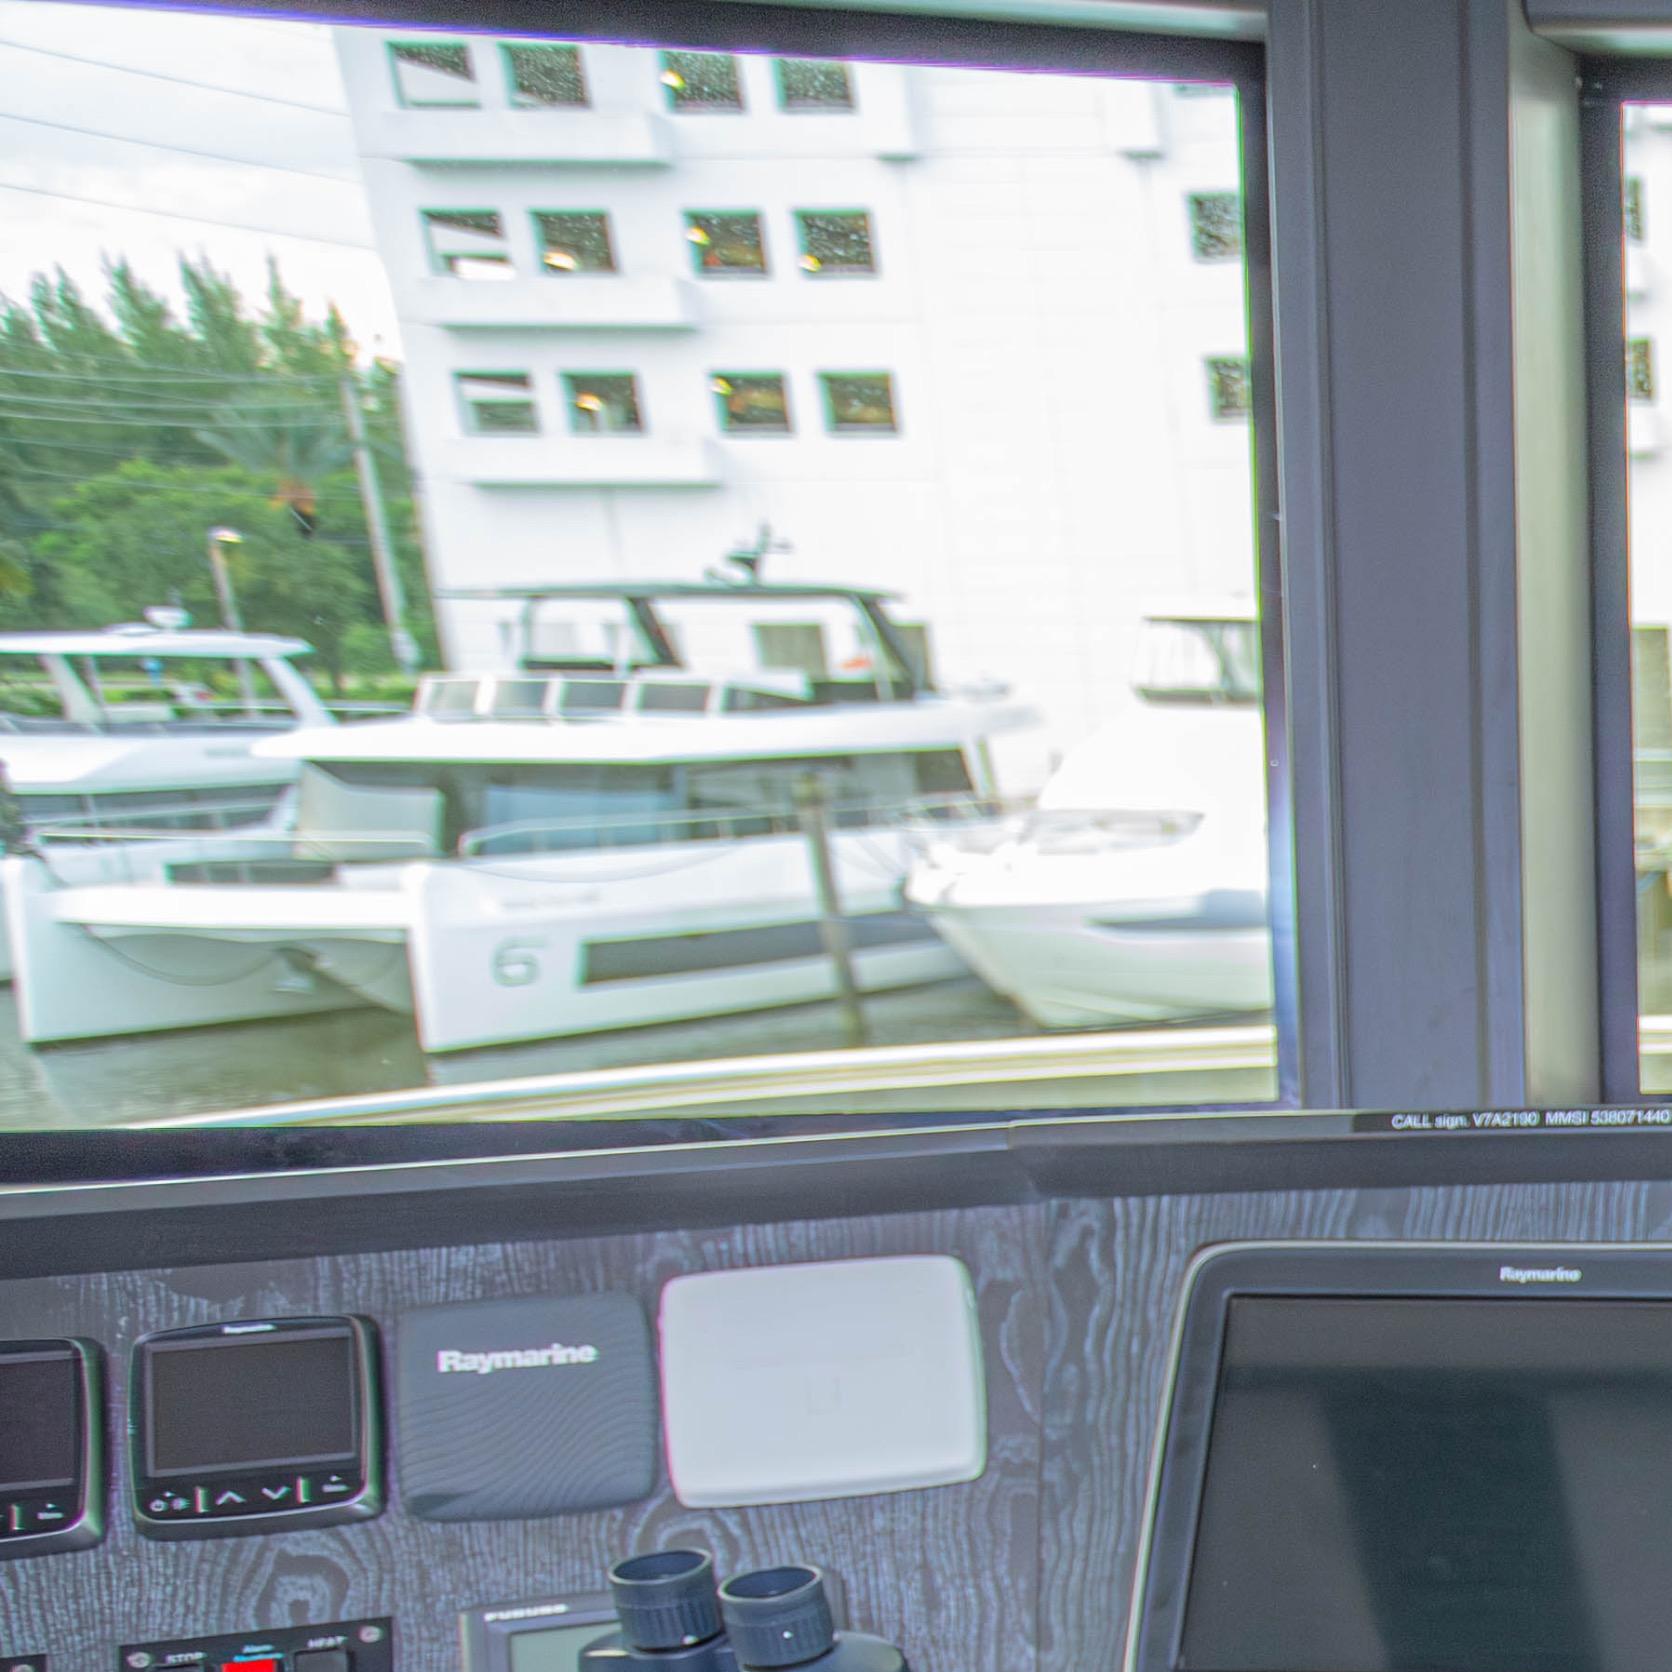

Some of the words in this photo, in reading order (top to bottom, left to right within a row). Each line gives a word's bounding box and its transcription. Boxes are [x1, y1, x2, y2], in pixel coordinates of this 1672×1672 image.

[1391, 1113, 1433, 1129] CALL
[1545, 1111, 1588, 1127] MMSI
[1499, 1266, 1583, 1284] Raymarine
[437, 1342, 599, 1375] Raymarine
